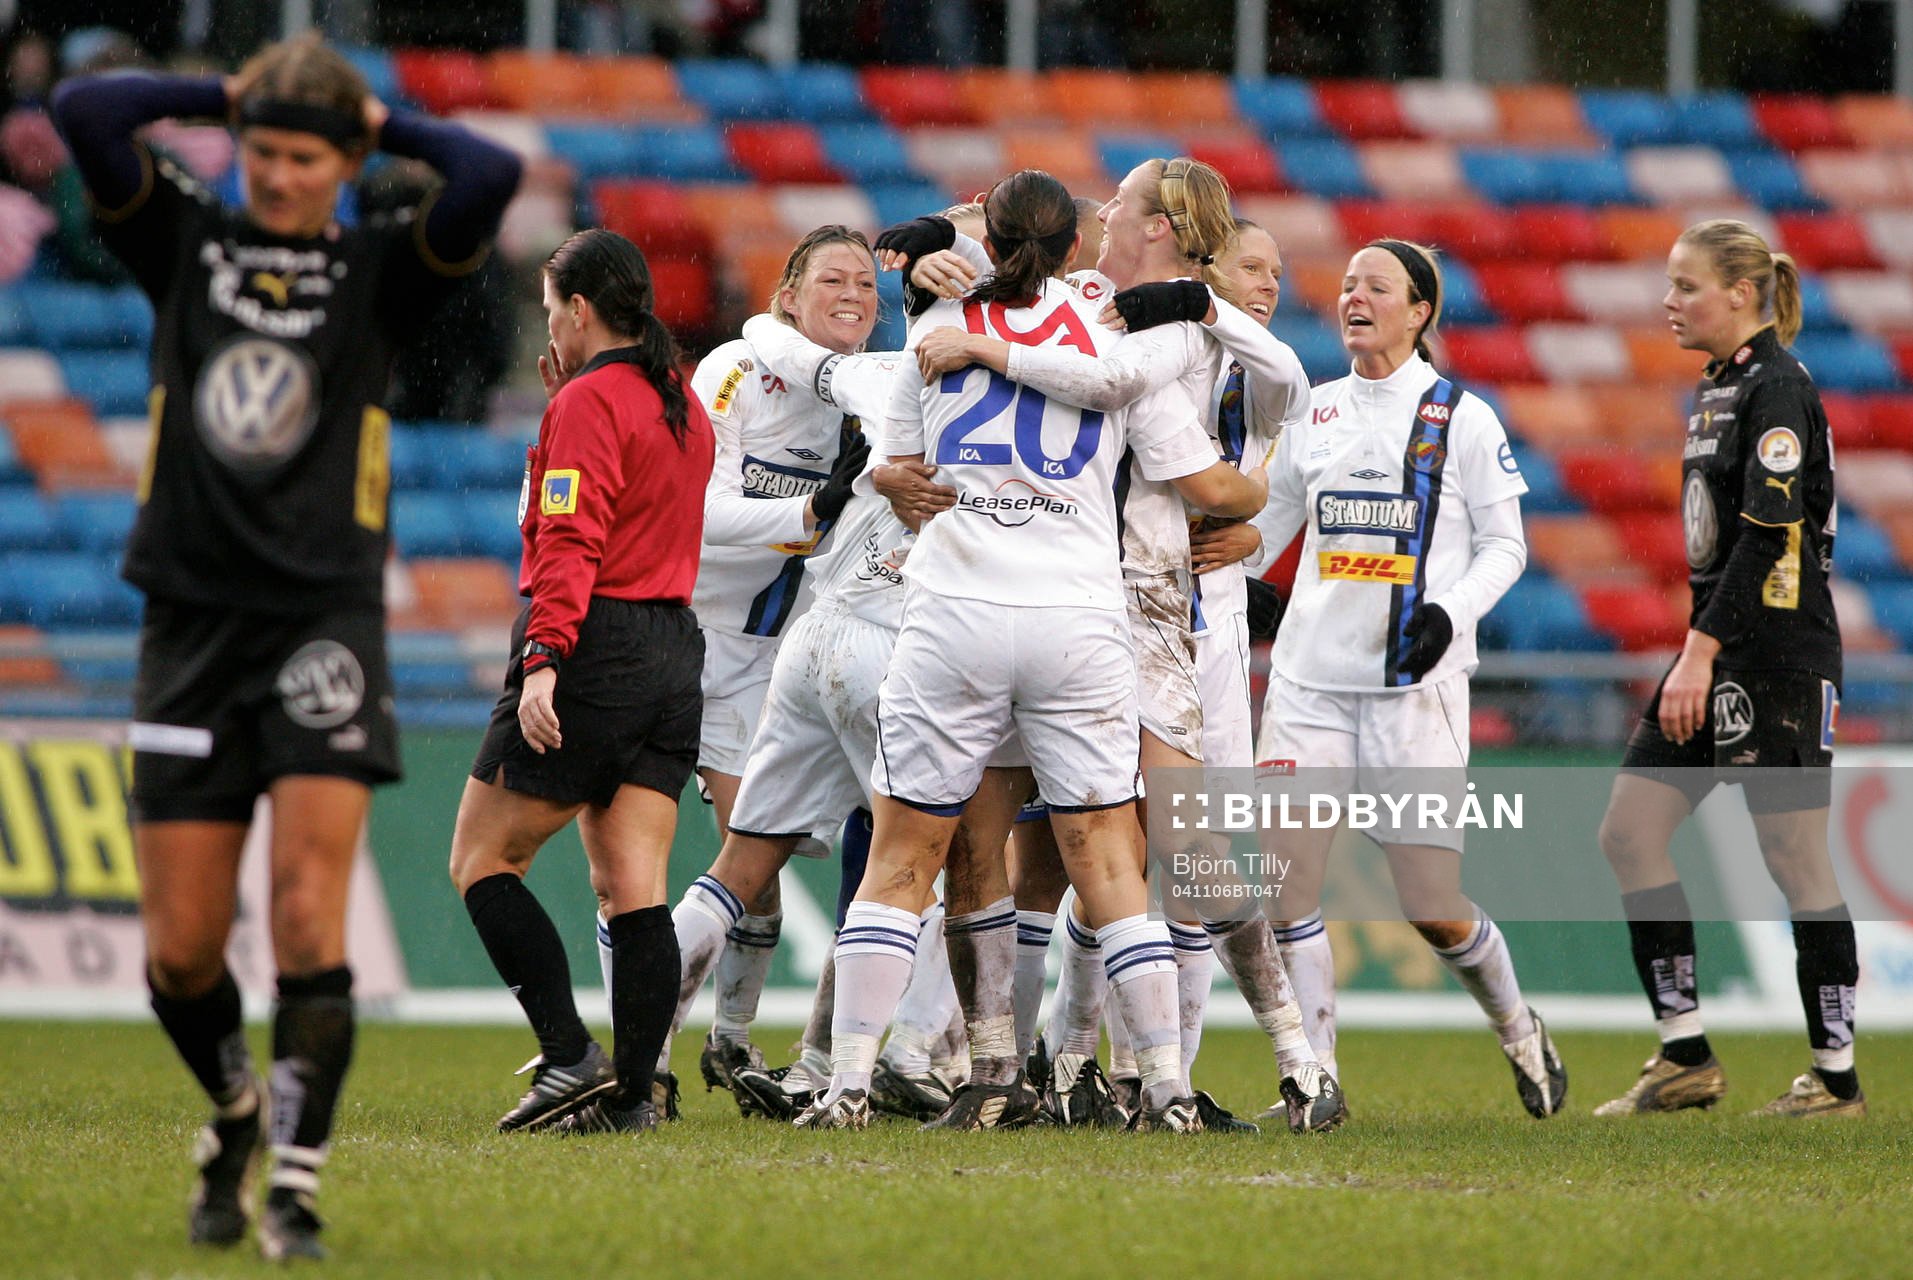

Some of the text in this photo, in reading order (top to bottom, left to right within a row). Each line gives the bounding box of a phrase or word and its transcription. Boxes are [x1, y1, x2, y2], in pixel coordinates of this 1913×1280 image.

[936, 364, 1104, 480] 20
[1312, 405, 1339, 425] ICA
[1421, 403, 1449, 420] AXA
[959, 448, 982, 461] ICA
[1043, 461, 1065, 475] ICA
[959, 491, 1078, 515] LeasePlan
[1321, 495, 1419, 532] STADIUM
[1329, 555, 1400, 578] DHL
[1819, 985, 1841, 1020] INTER
